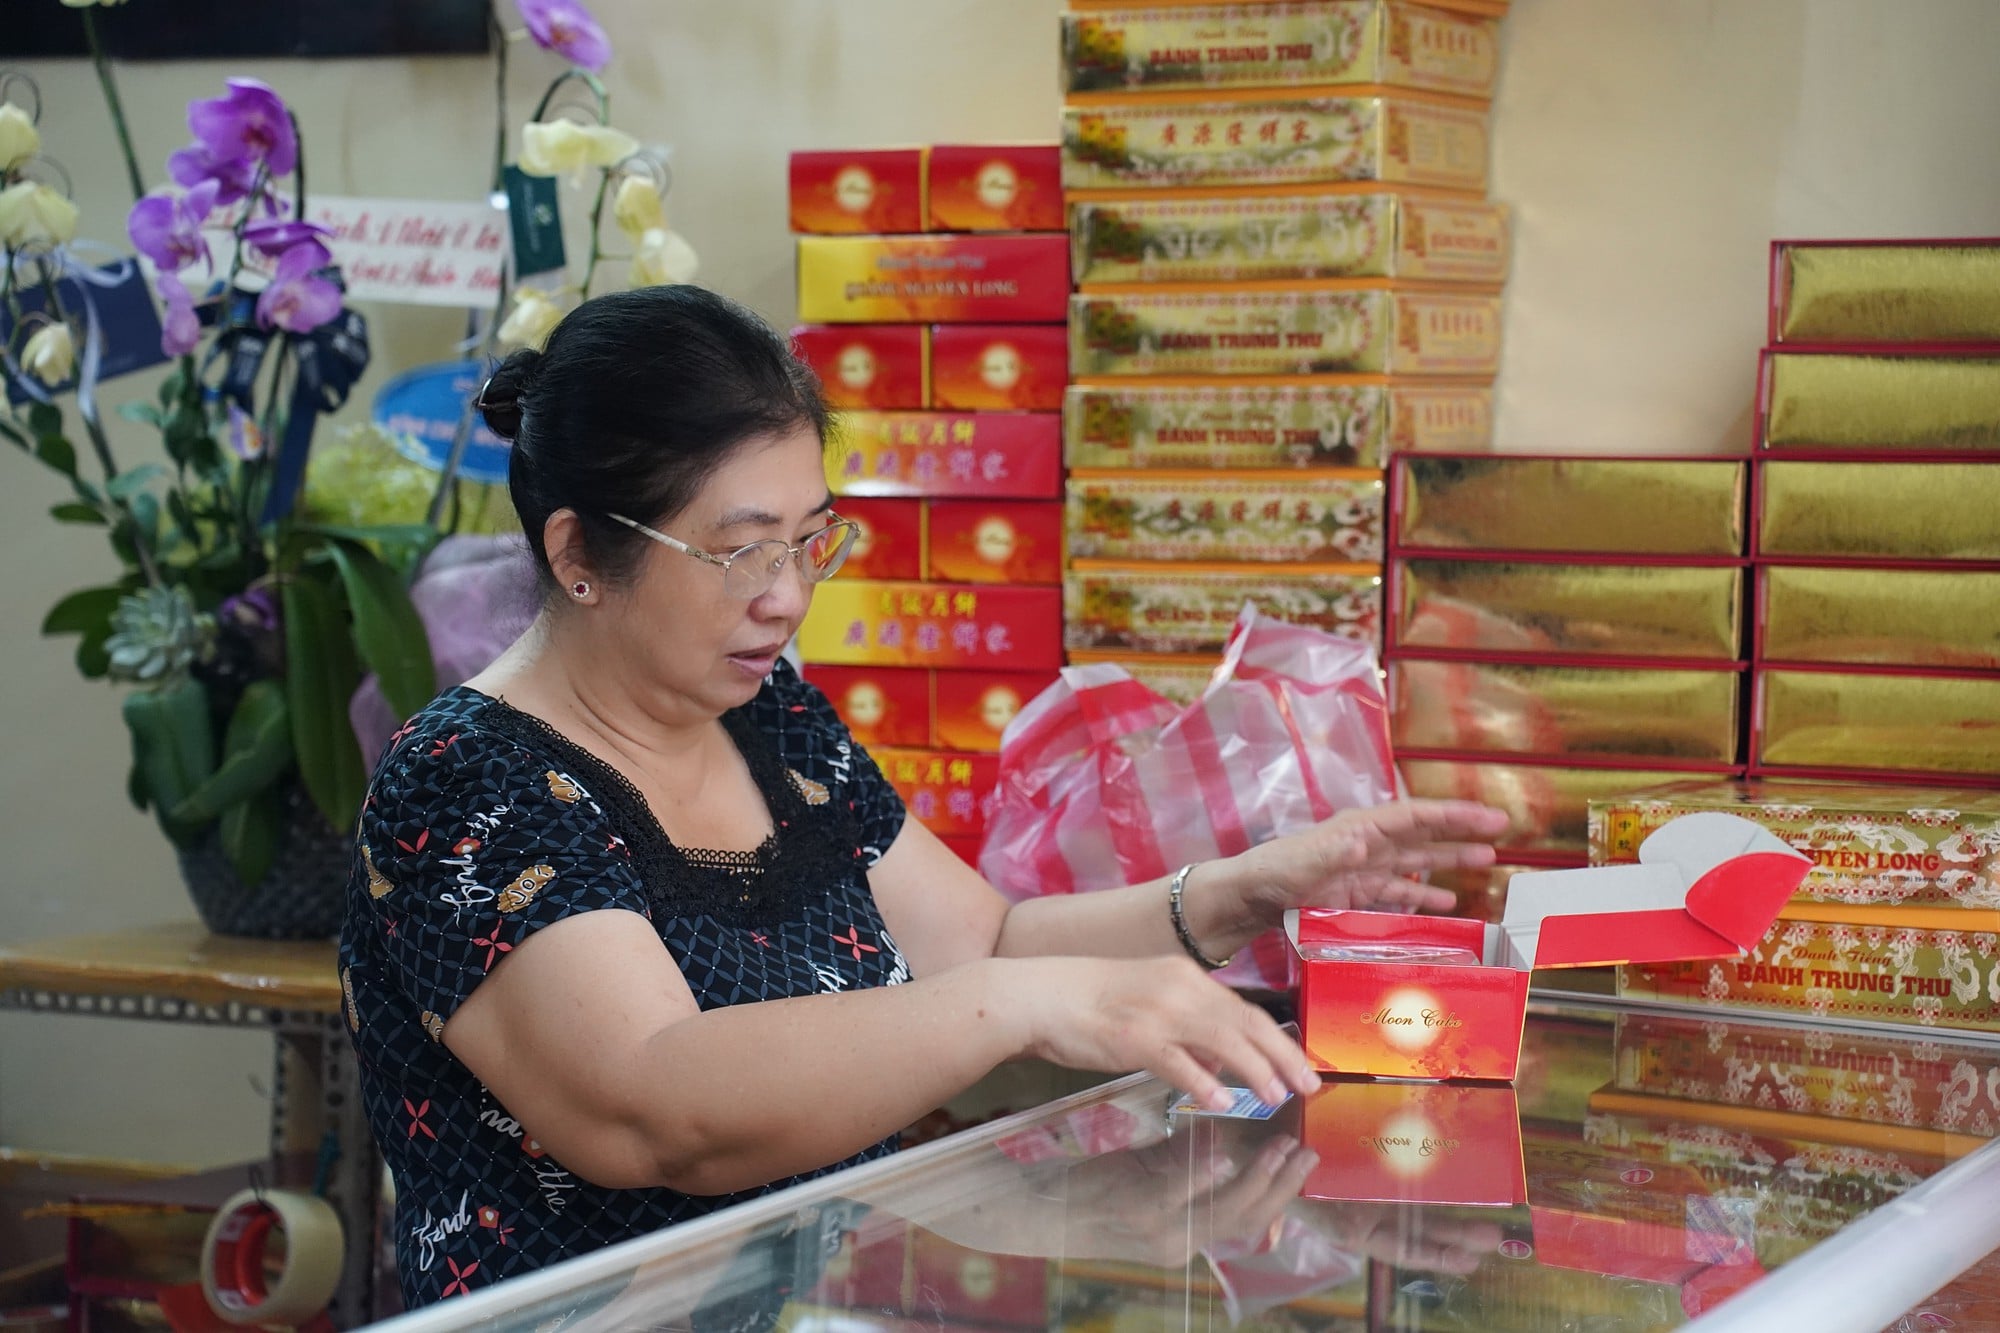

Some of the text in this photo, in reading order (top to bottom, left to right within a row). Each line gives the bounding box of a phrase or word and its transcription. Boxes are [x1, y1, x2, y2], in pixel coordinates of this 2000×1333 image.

[1797, 846, 1939, 871] UYÊN LONG
[1792, 949, 1893, 967] Danh Tiếng
[1737, 962, 1952, 998] BÁNH TRUNG THU
[1361, 1008, 1463, 1029] Moon Cake
[411, 1188, 472, 1272] find
